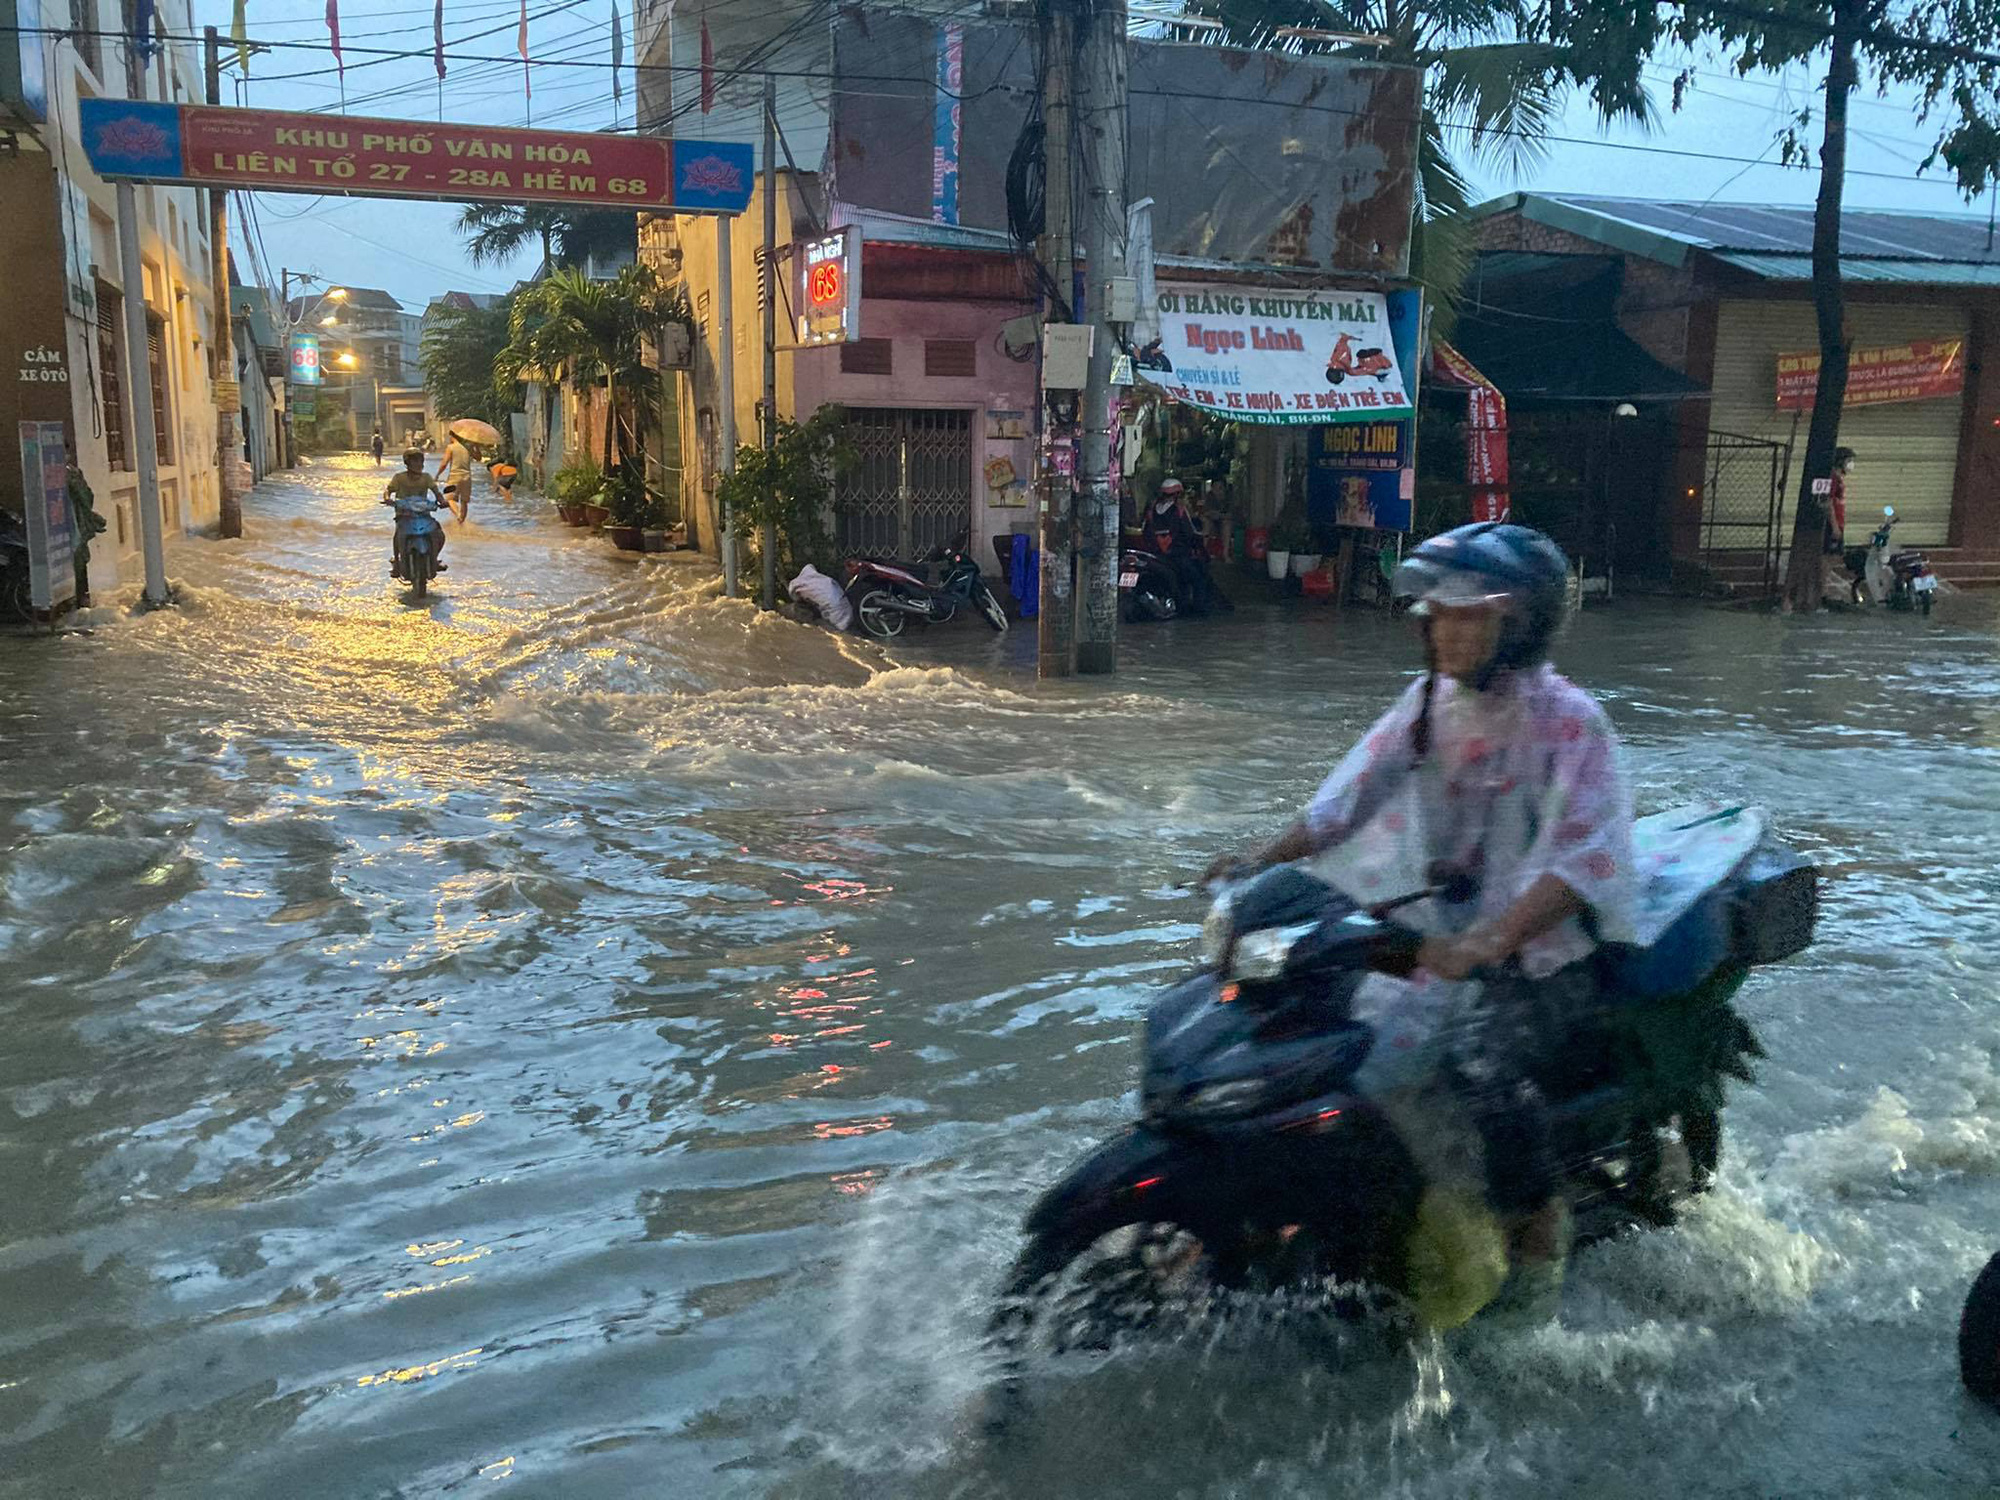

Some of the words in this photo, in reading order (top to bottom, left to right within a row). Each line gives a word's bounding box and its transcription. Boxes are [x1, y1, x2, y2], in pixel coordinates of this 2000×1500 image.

[275, 128, 349, 149] KHU
[362, 131, 432, 154] PHỐ
[445, 138, 513, 160] VĂN
[525, 143, 592, 166] HÓA
[213, 151, 297, 175] LIÊN
[308, 153, 356, 179] TỔ
[369, 163, 411, 181] 27
[448, 169, 511, 188] 28A
[523, 168, 596, 193] HẺM
[608, 177, 647, 195] 68
[812, 264, 838, 302] 68
[1184, 289, 1246, 315] HÀNG
[1248, 292, 1334, 321] KHUYẾN
[1337, 298, 1377, 322] MÃI
[1184, 323, 1246, 355] Ngọc
[1250, 325, 1305, 352] Linh
[292, 348, 319, 367] 68
[19, 369, 38, 381] XE
[40, 367, 68, 382] ÔTÔ
[1176, 366, 1210, 384] CHUYÊN
[1222, 370, 1230, 385] &
[1230, 366, 1241, 386] LẺ
[1194, 389, 1216, 406] EM
[1225, 391, 1243, 408] XE
[1247, 392, 1285, 414] NHỰA
[1294, 393, 1313, 410] XE
[1315, 389, 1350, 411] ĐIỆN
[1350, 387, 1381, 407] TRẺ
[1382, 391, 1405, 406] EM
[1323, 426, 1360, 457] NGỌC
[1363, 425, 1397, 453] LINH
